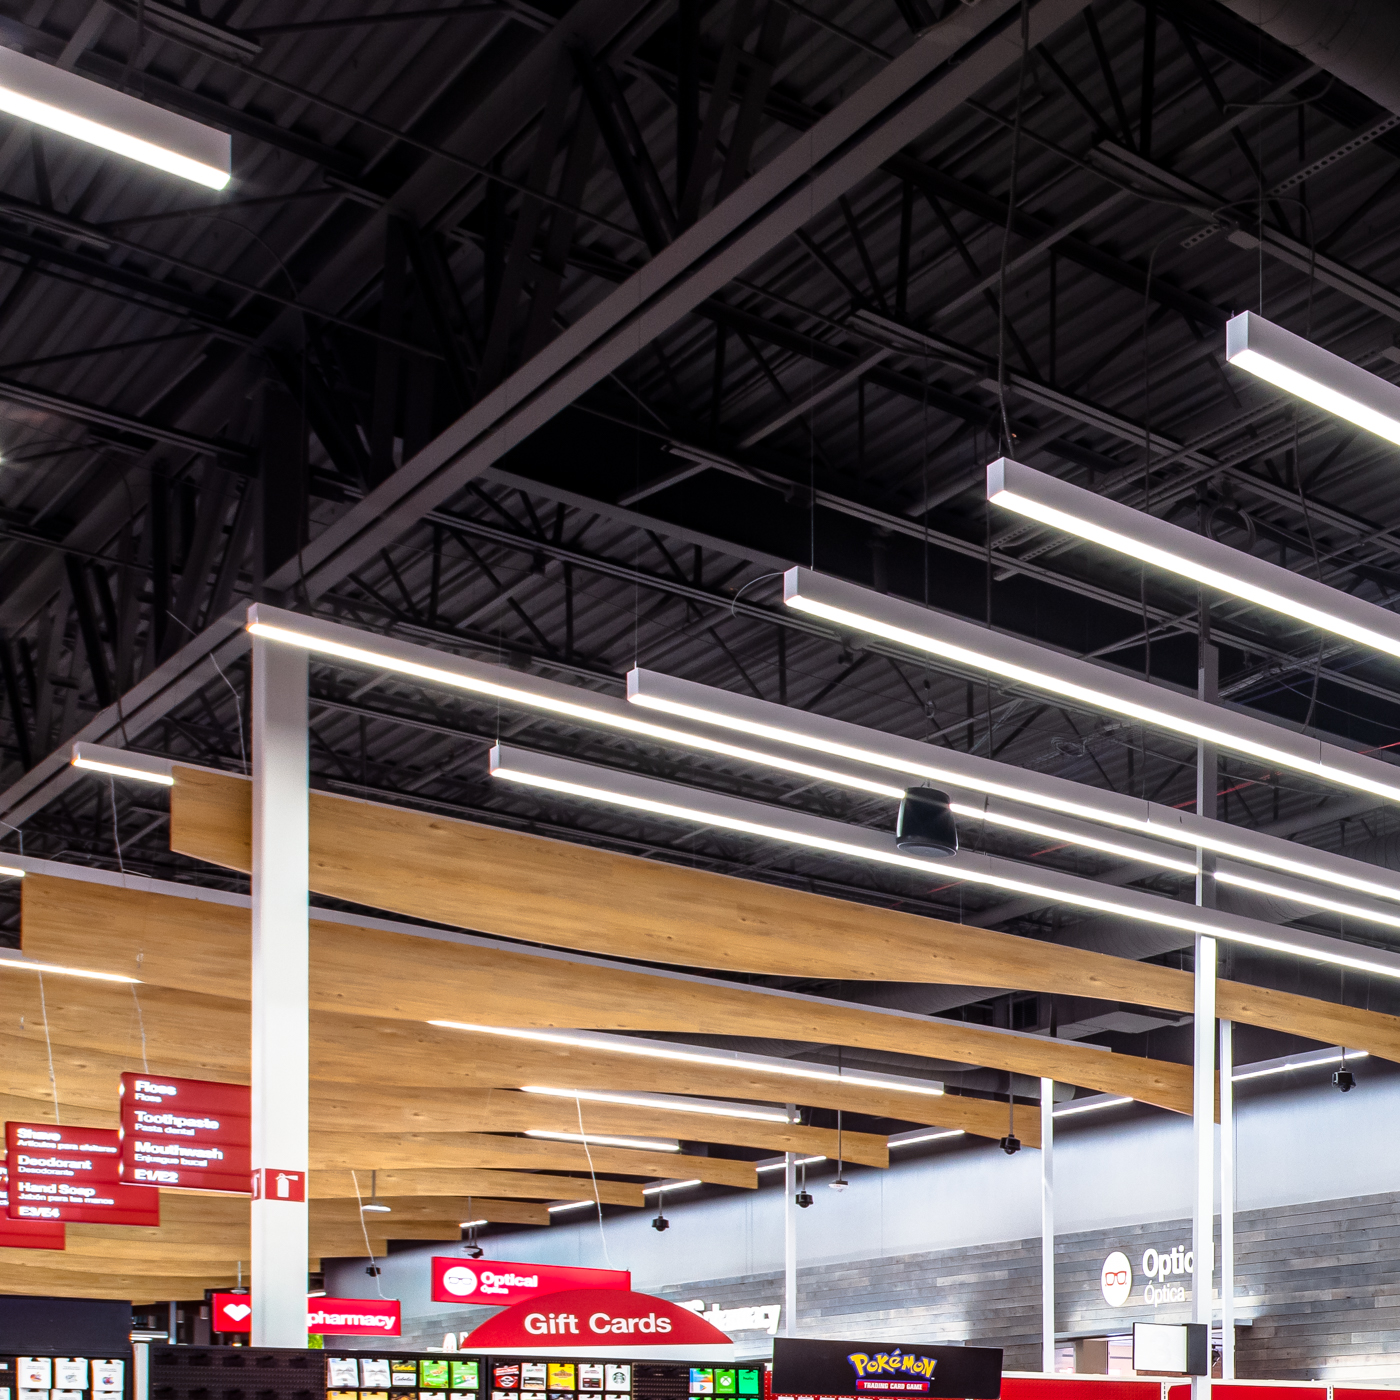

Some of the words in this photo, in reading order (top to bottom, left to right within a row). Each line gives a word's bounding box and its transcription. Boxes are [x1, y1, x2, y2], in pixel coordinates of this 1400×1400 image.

[134, 1080, 177, 1096] Floss
[134, 1110, 220, 1130] Toothpaste
[134, 1141, 224, 1160] Mouthwash
[18, 1155, 92, 1170] Deodorant
[1142, 1245, 1200, 1281] Optic
[480, 1271, 539, 1289] Optical
[307, 1309, 396, 1330] pharmacy
[524, 1312, 578, 1335] Gift
[588, 1312, 672, 1334] Cards
[890, 1382, 905, 1390] CARD
[906, 1383, 923, 1391] GAME
